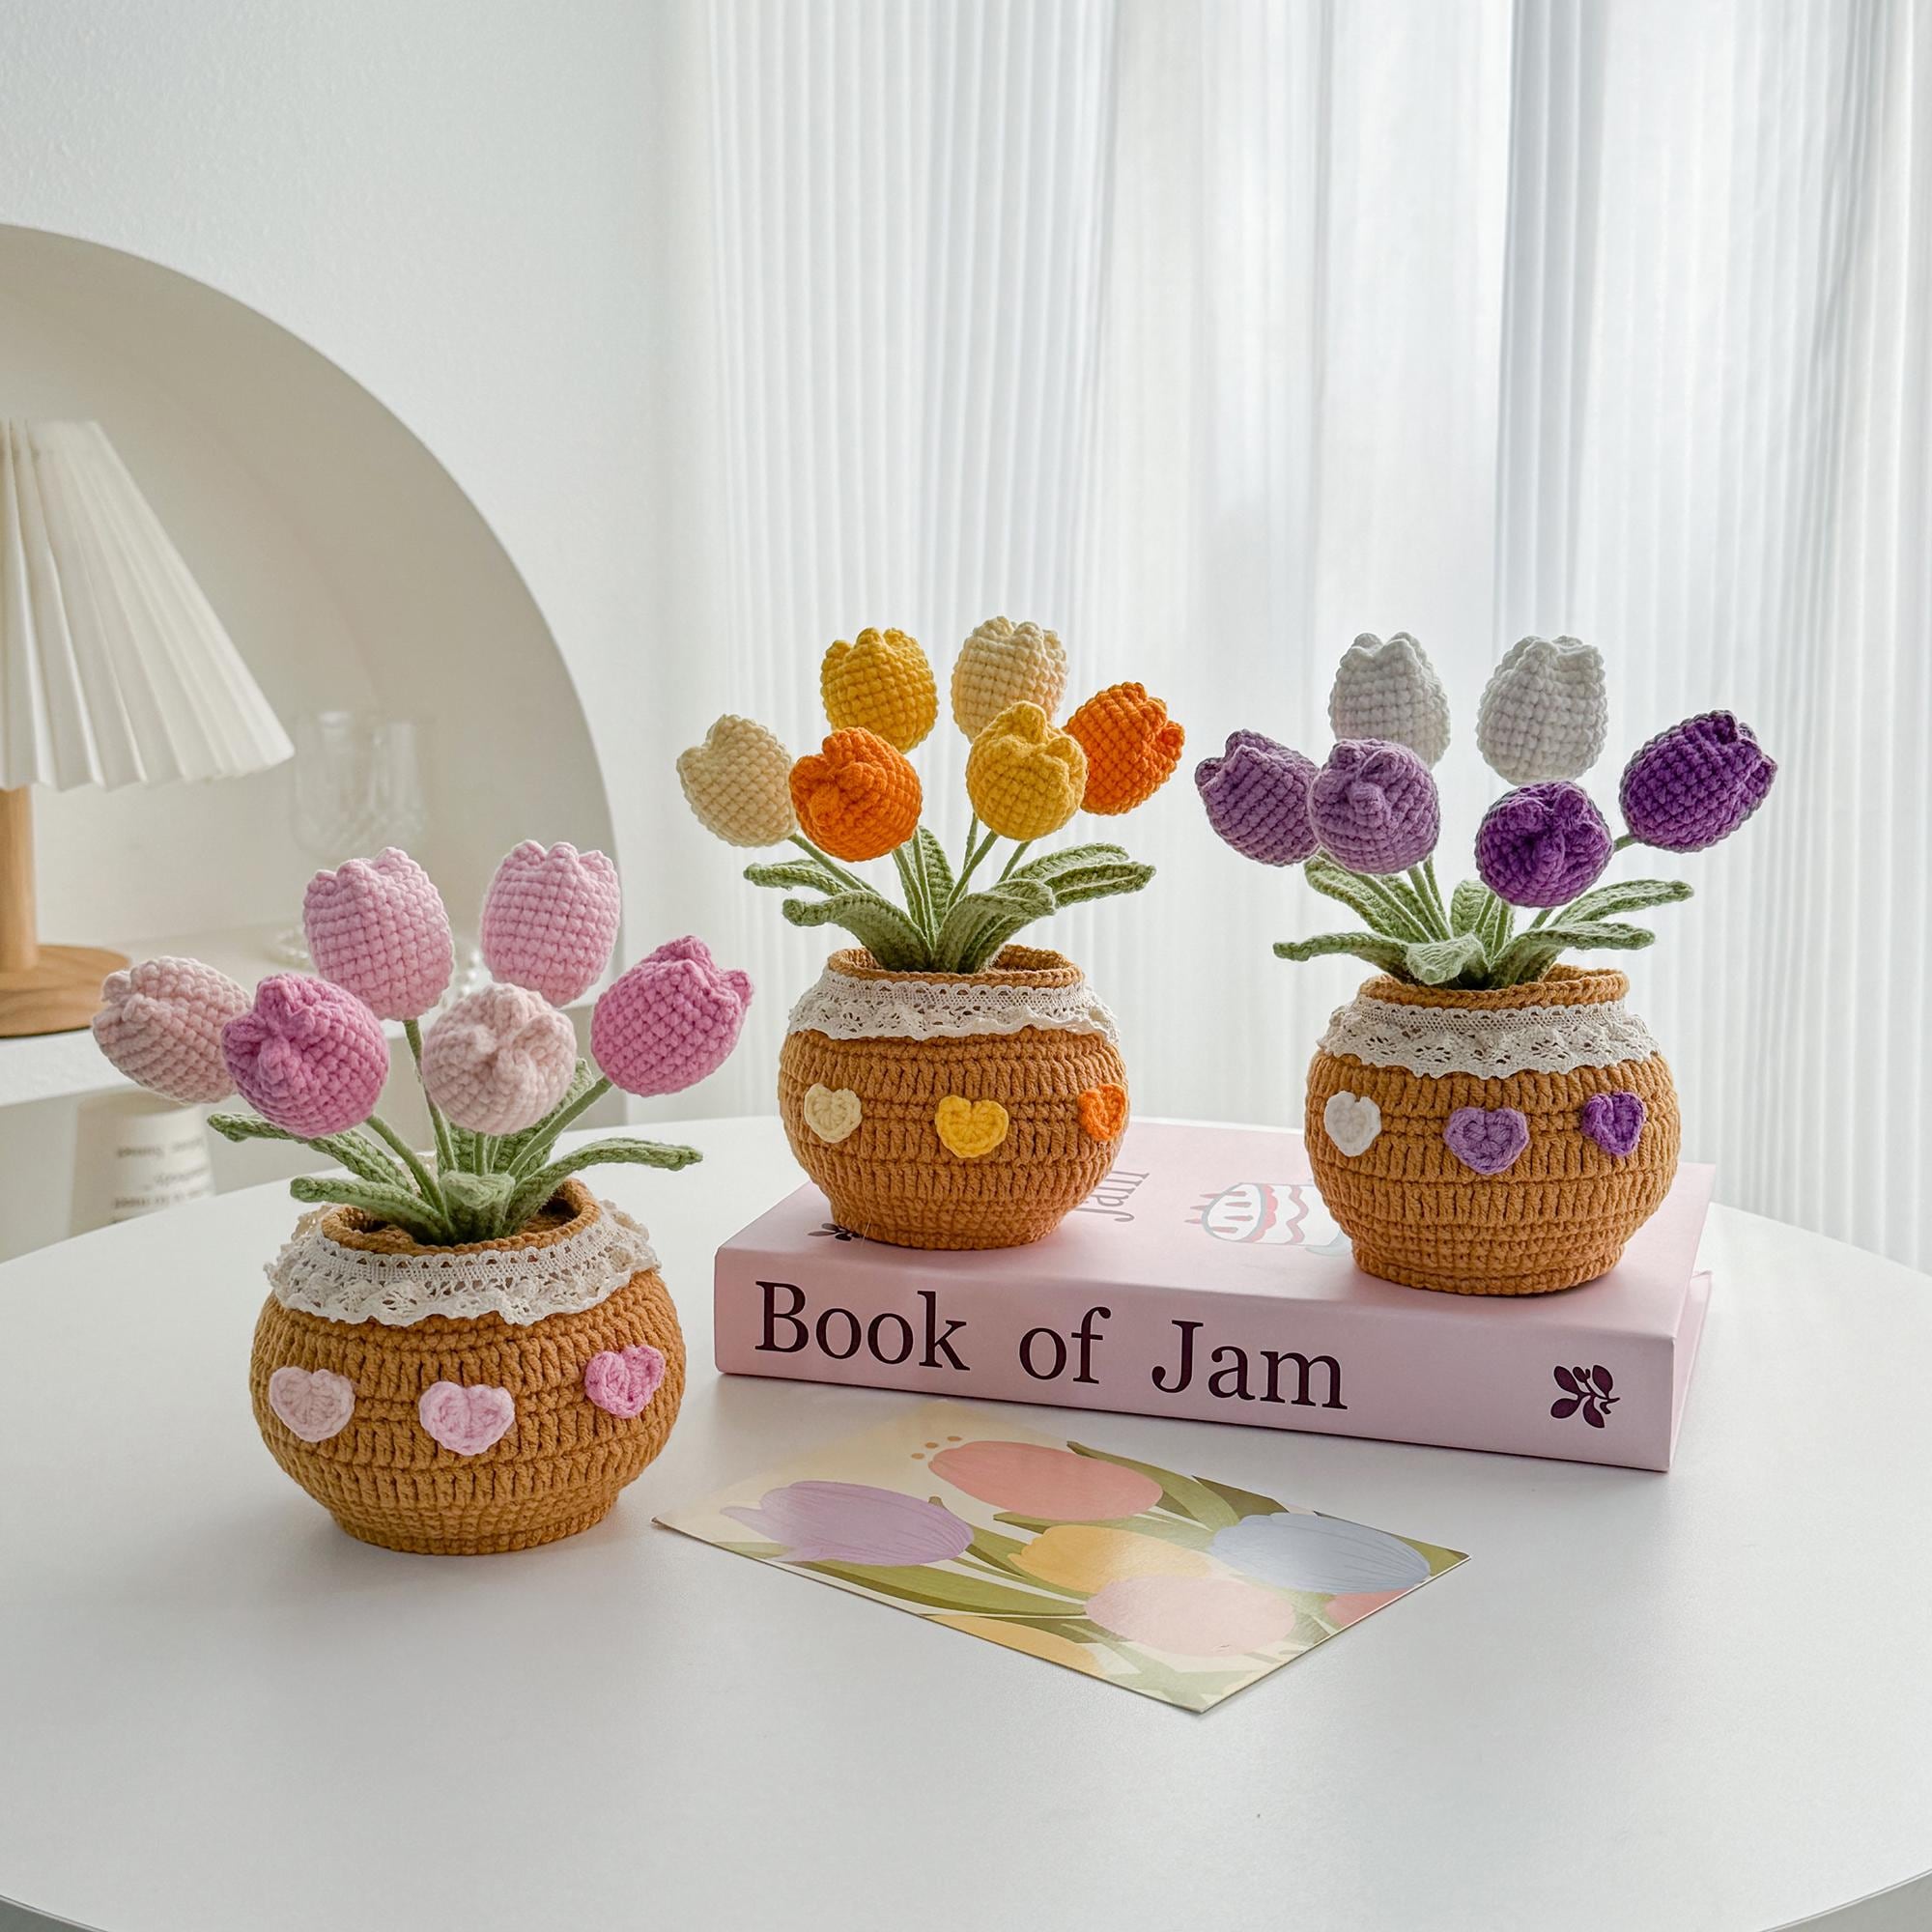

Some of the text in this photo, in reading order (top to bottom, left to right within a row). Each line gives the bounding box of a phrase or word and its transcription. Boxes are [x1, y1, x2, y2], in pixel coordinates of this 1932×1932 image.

[755, 1280, 1349, 1410] Book of Jam
